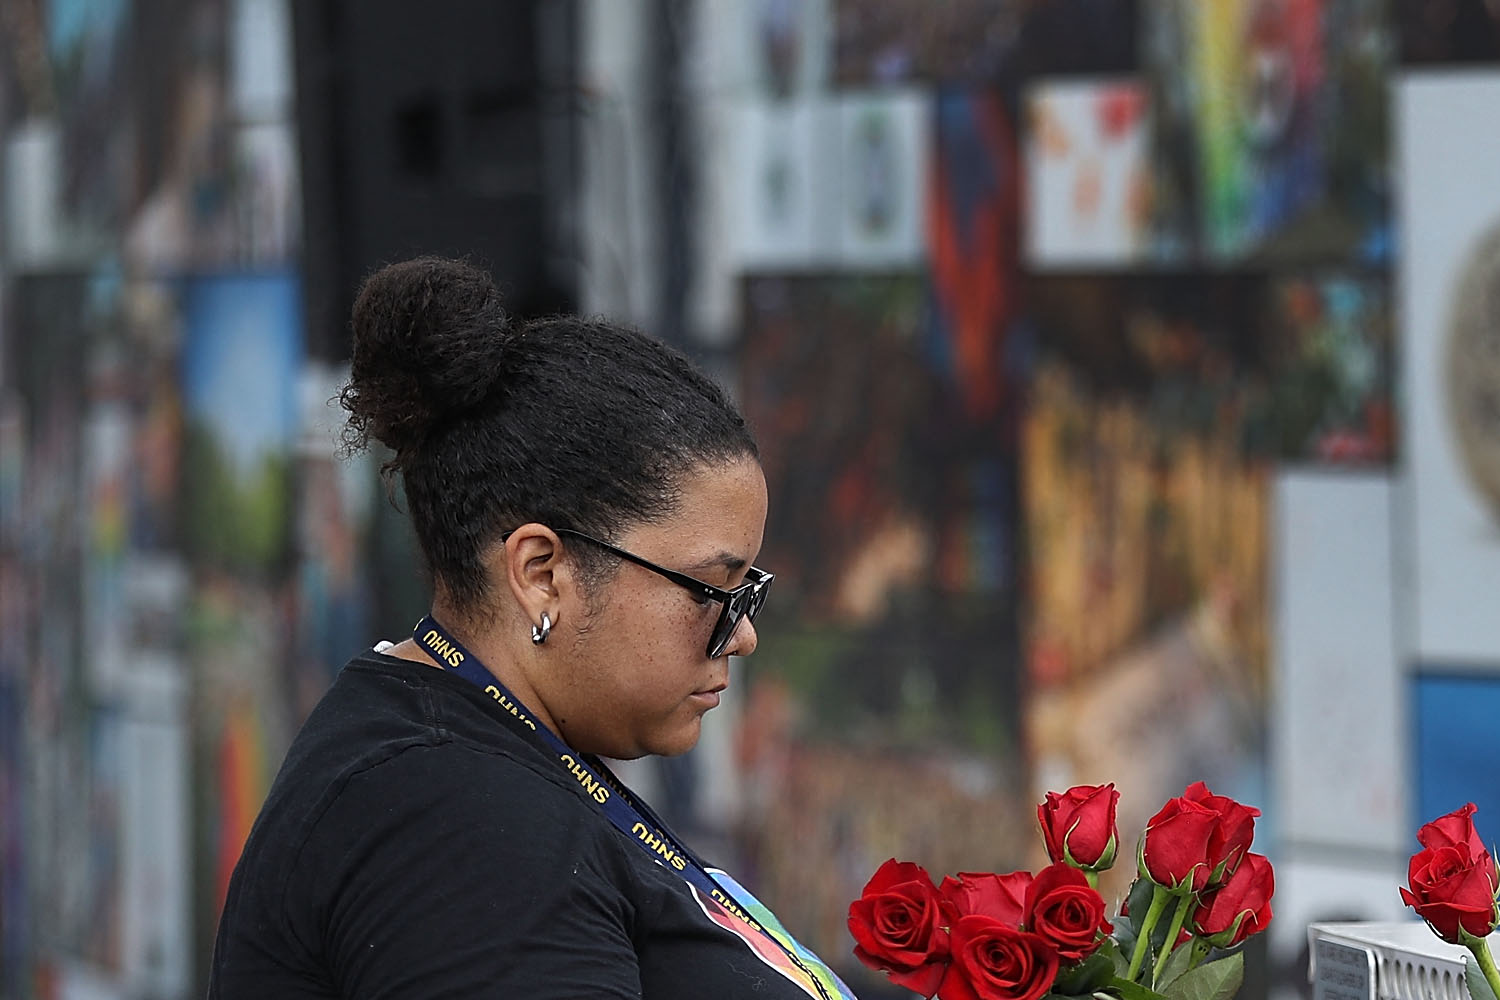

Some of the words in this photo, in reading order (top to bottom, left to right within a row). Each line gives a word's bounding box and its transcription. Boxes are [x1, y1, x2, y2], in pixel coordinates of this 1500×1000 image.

[423, 629, 465, 668] SNHU
[560, 754, 610, 804] SNHU
[631, 822, 687, 871] SNHU
